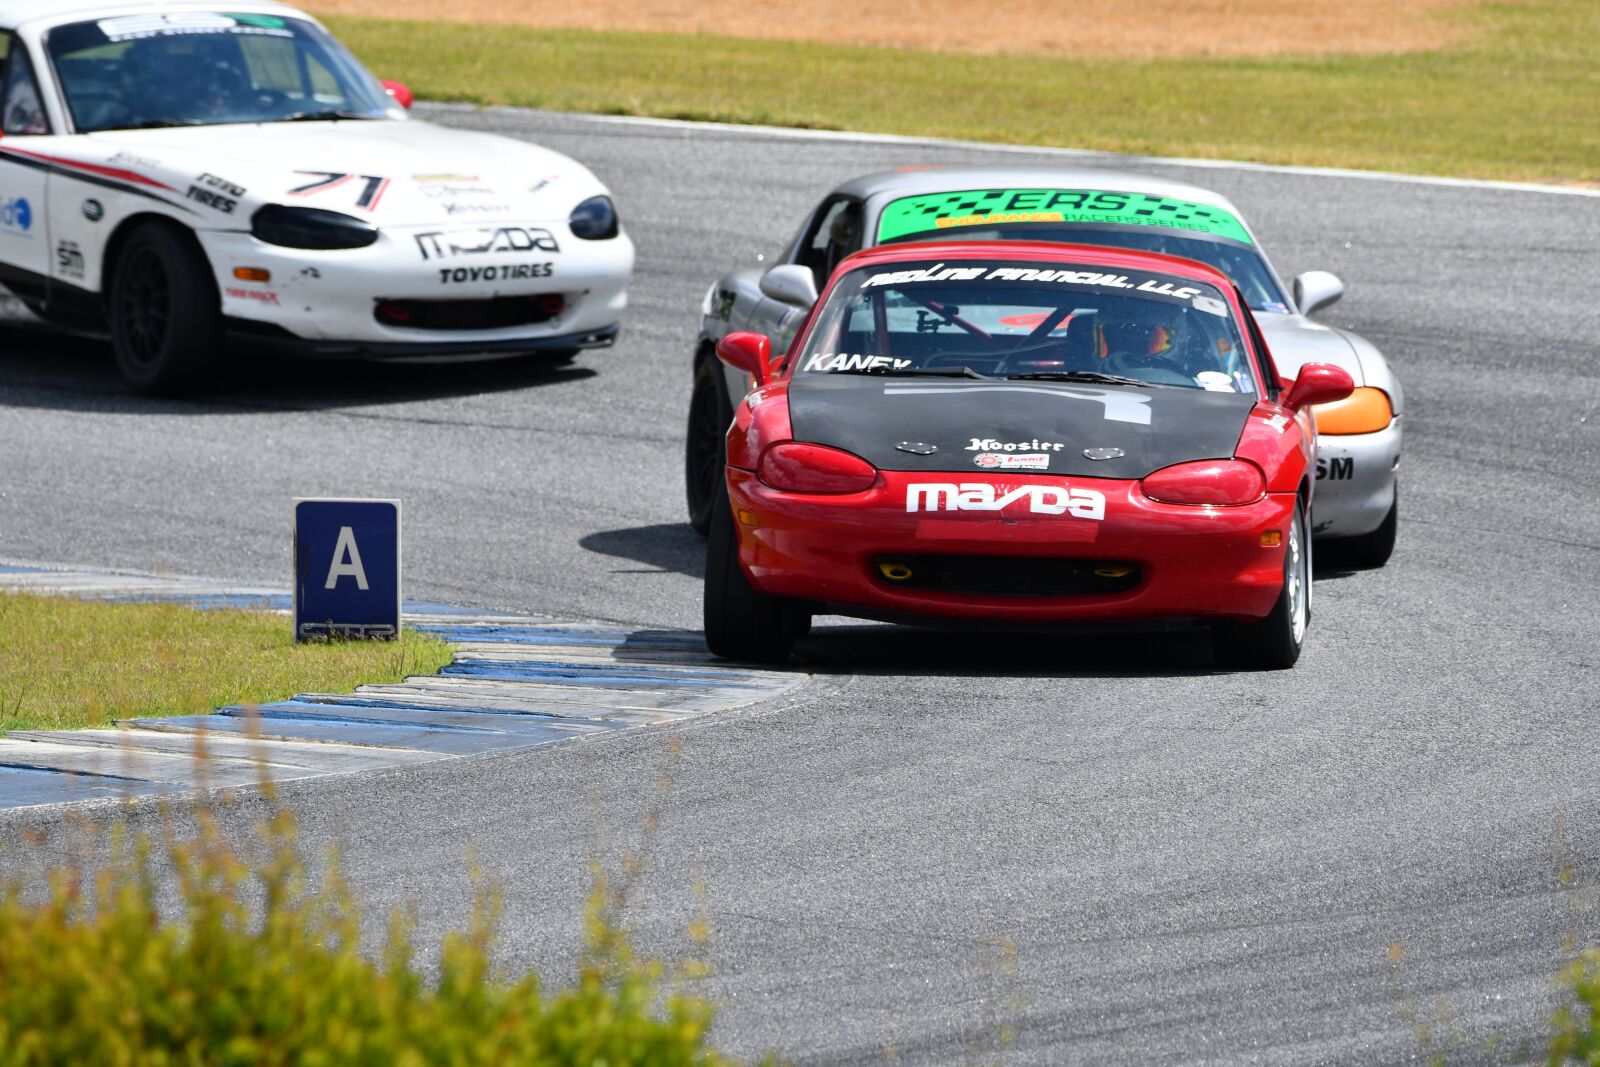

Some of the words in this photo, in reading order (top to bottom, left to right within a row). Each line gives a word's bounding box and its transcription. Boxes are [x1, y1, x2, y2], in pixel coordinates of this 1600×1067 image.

[287, 170, 391, 212] 71
[1004, 191, 1131, 211] ERS
[1063, 213, 1142, 225] RACERS
[1145, 217, 1211, 232] SERIES
[440, 266, 497, 284] TOYO
[500, 262, 554, 279] TIRES
[964, 437, 1065, 452] Hoosier
[324, 525, 370, 590] A
